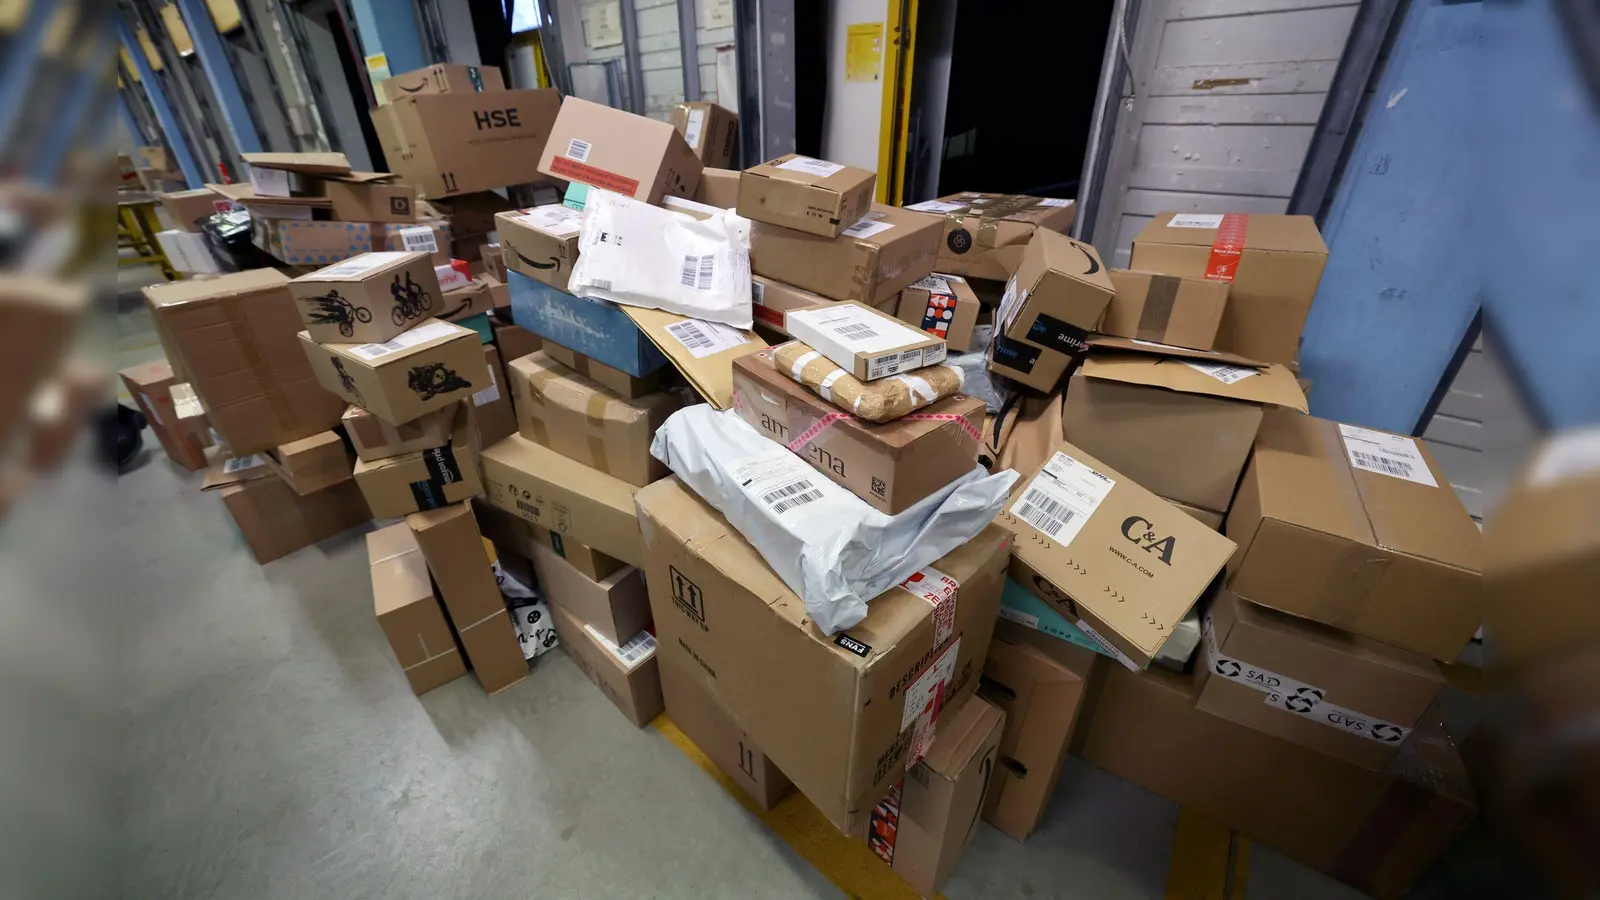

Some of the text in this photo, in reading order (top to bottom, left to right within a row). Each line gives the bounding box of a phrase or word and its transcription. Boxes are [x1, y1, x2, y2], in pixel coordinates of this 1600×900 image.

[473, 108, 522, 131] HSE
[1057, 332, 1084, 348] rime
[761, 413, 847, 479] amena
[1120, 515, 1176, 567] C&A
[1032, 574, 1080, 619] C&A
[1246, 670, 1281, 688] SAD
[1327, 712, 1366, 732] SAD
